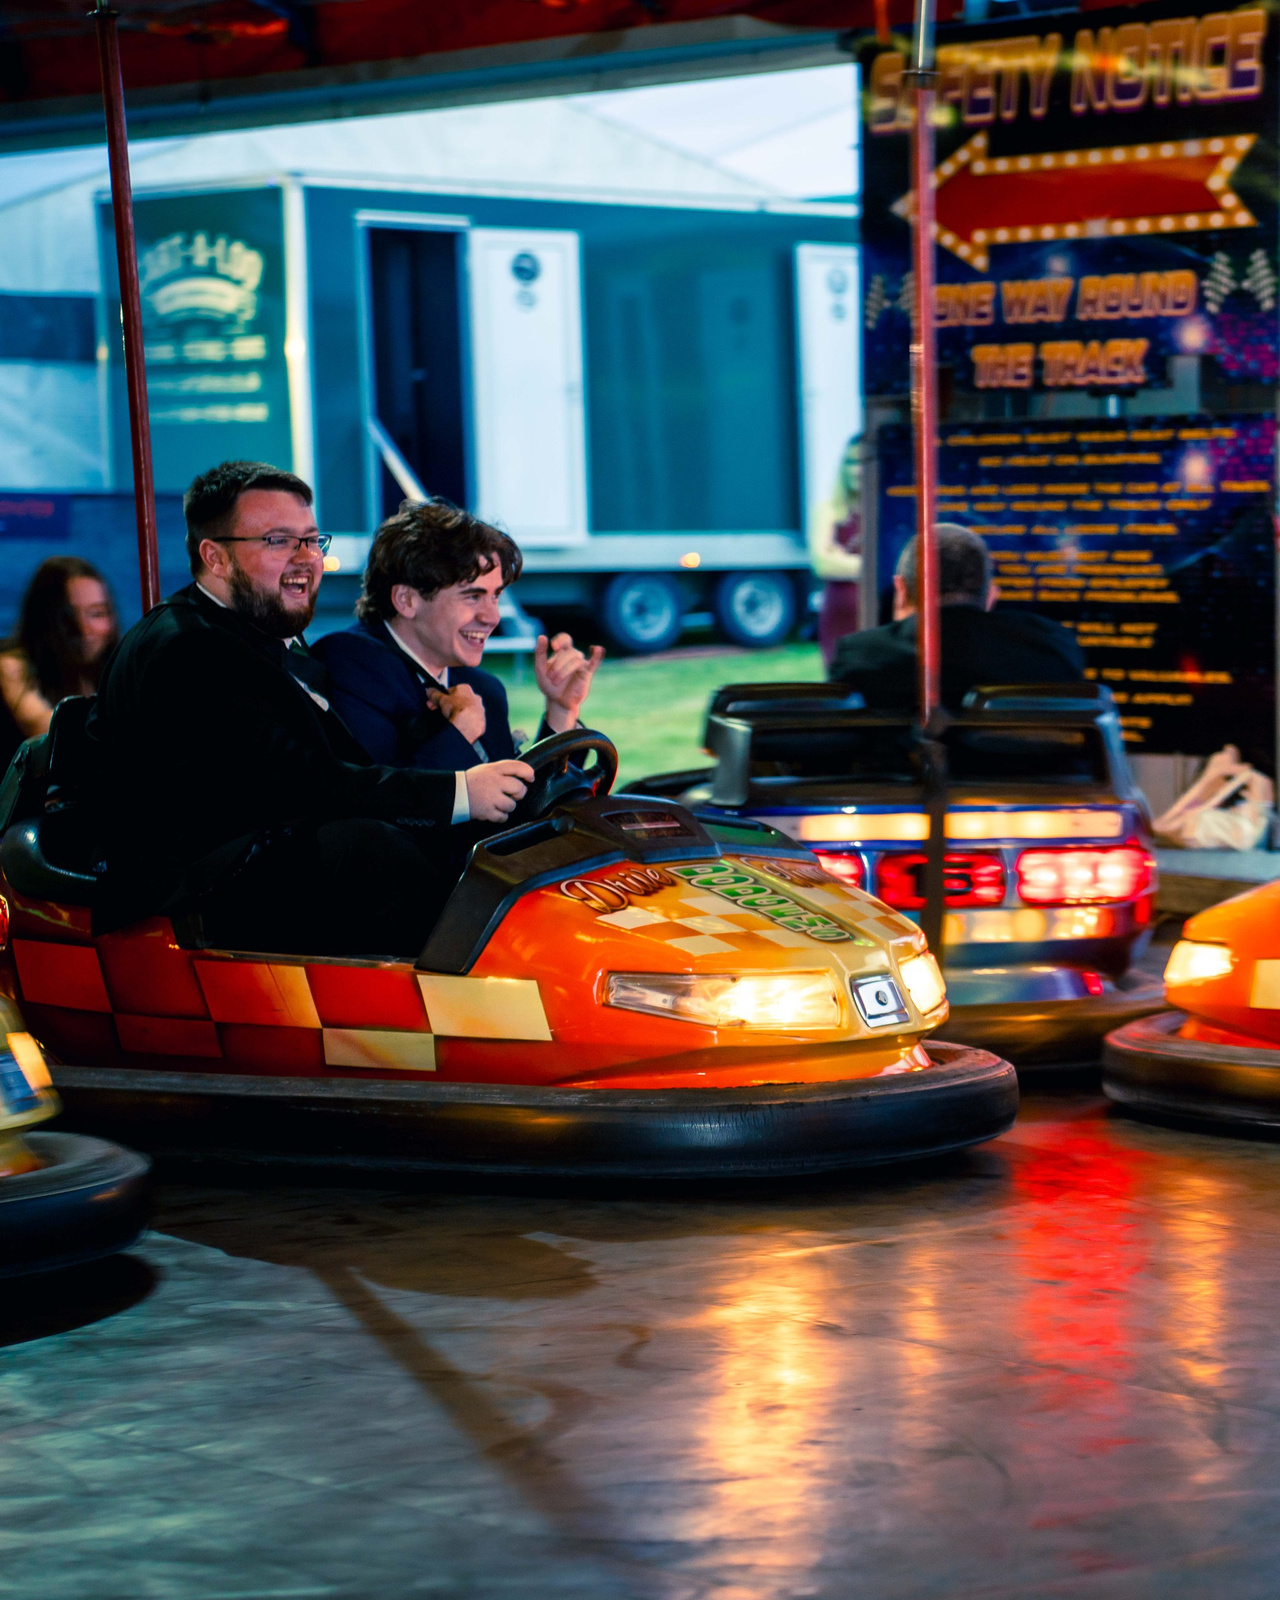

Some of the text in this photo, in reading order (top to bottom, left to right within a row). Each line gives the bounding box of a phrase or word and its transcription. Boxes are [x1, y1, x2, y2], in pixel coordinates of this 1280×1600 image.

[869, 9, 1267, 133] SFETY NOTICE
[1001, 277, 1074, 324] WAY
[1076, 269, 1197, 321] ROUND
[971, 338, 1149, 388] THE TRACK
[559, 866, 673, 914] Drive
[664, 863, 851, 942] DODGEMS
